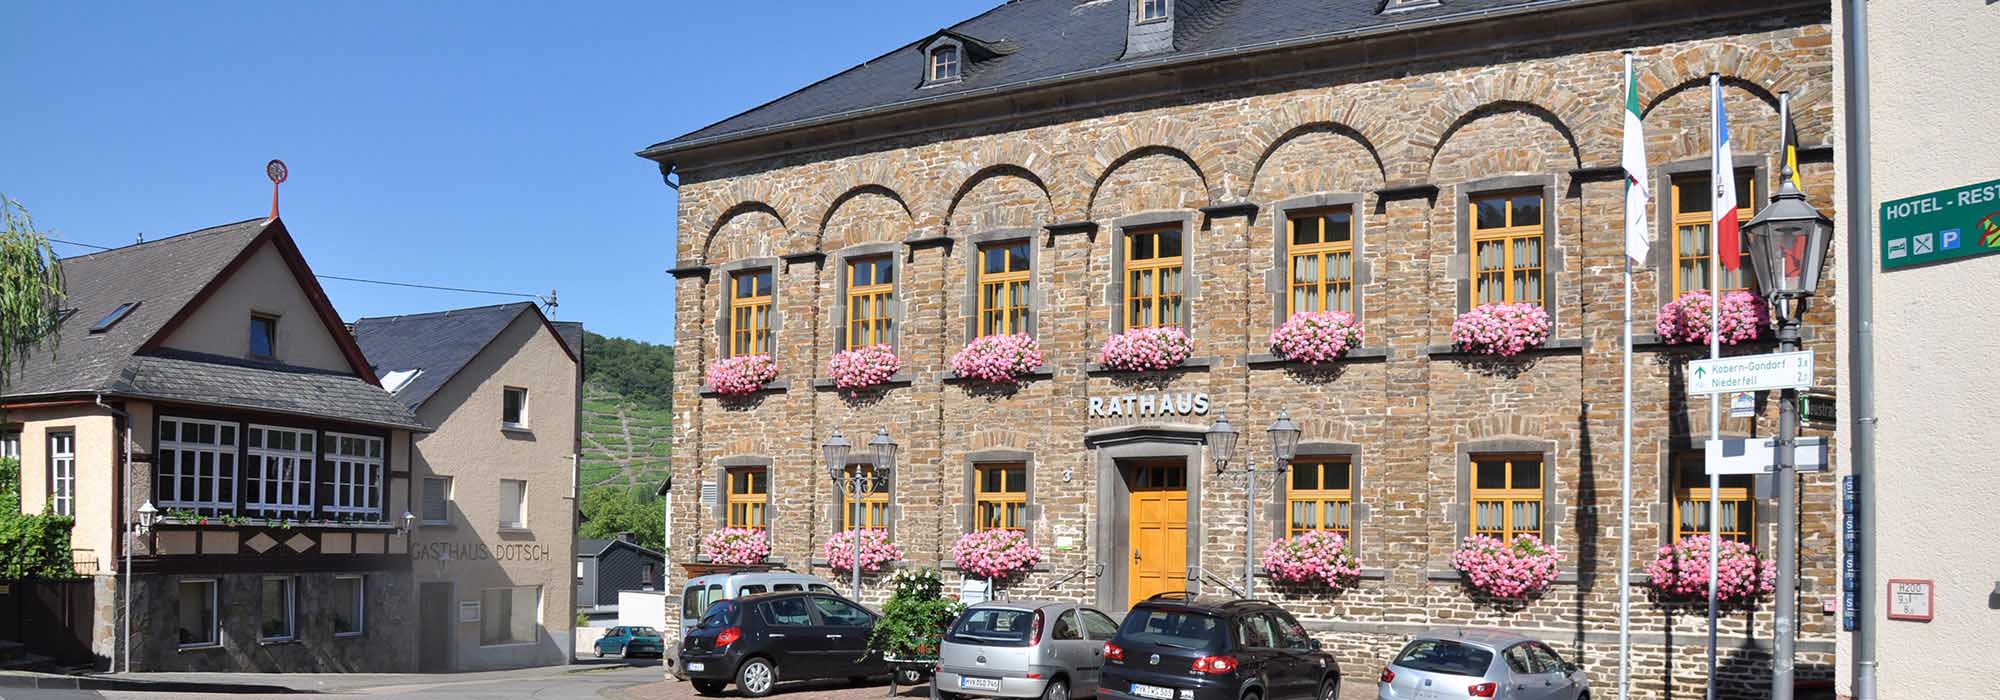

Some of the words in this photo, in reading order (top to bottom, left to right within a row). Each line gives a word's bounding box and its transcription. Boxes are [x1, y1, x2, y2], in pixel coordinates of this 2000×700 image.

[1887, 197, 1943, 220] HOTEL
[1711, 359, 1786, 374] Kobern-Gondorf
[1711, 375, 1757, 388] Niederfell
[1088, 392, 1210, 418] RATHAUS
[1062, 468, 1073, 482] 3
[411, 542, 489, 560] GASTHAUS
